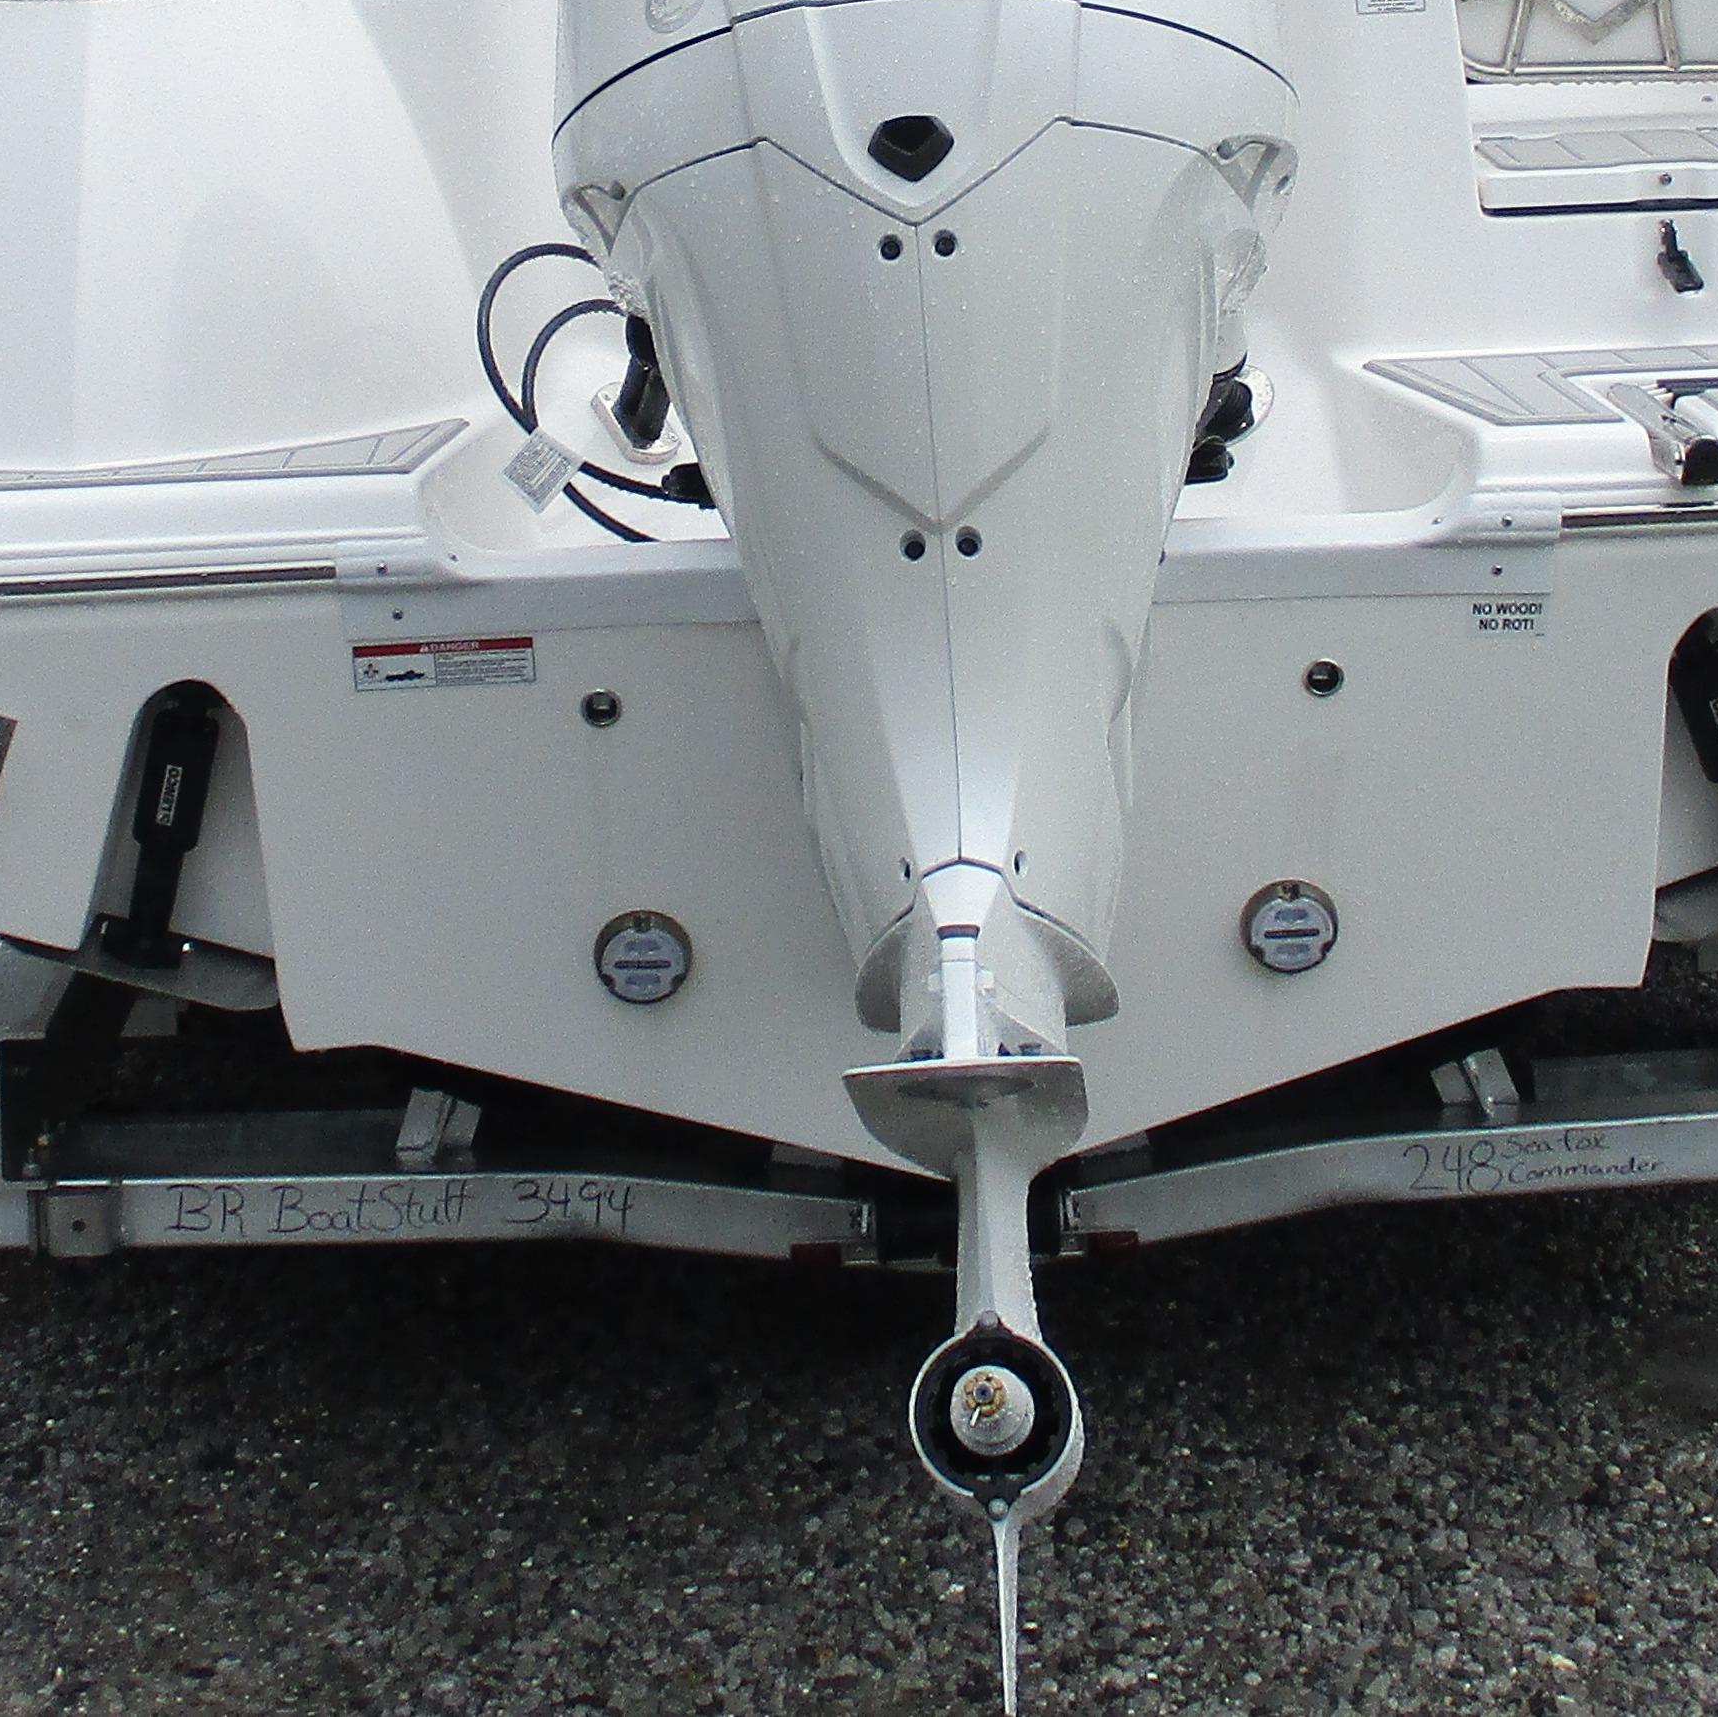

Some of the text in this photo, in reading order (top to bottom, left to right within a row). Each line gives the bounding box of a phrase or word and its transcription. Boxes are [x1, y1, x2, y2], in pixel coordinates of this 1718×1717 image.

[1472, 602, 1543, 615] NO WOOD!
[1478, 619, 1499, 631] NO
[428, 640, 480, 652] DANGER
[1403, 1139, 1503, 1194] 248
[165, 1183, 246, 1236] BR
